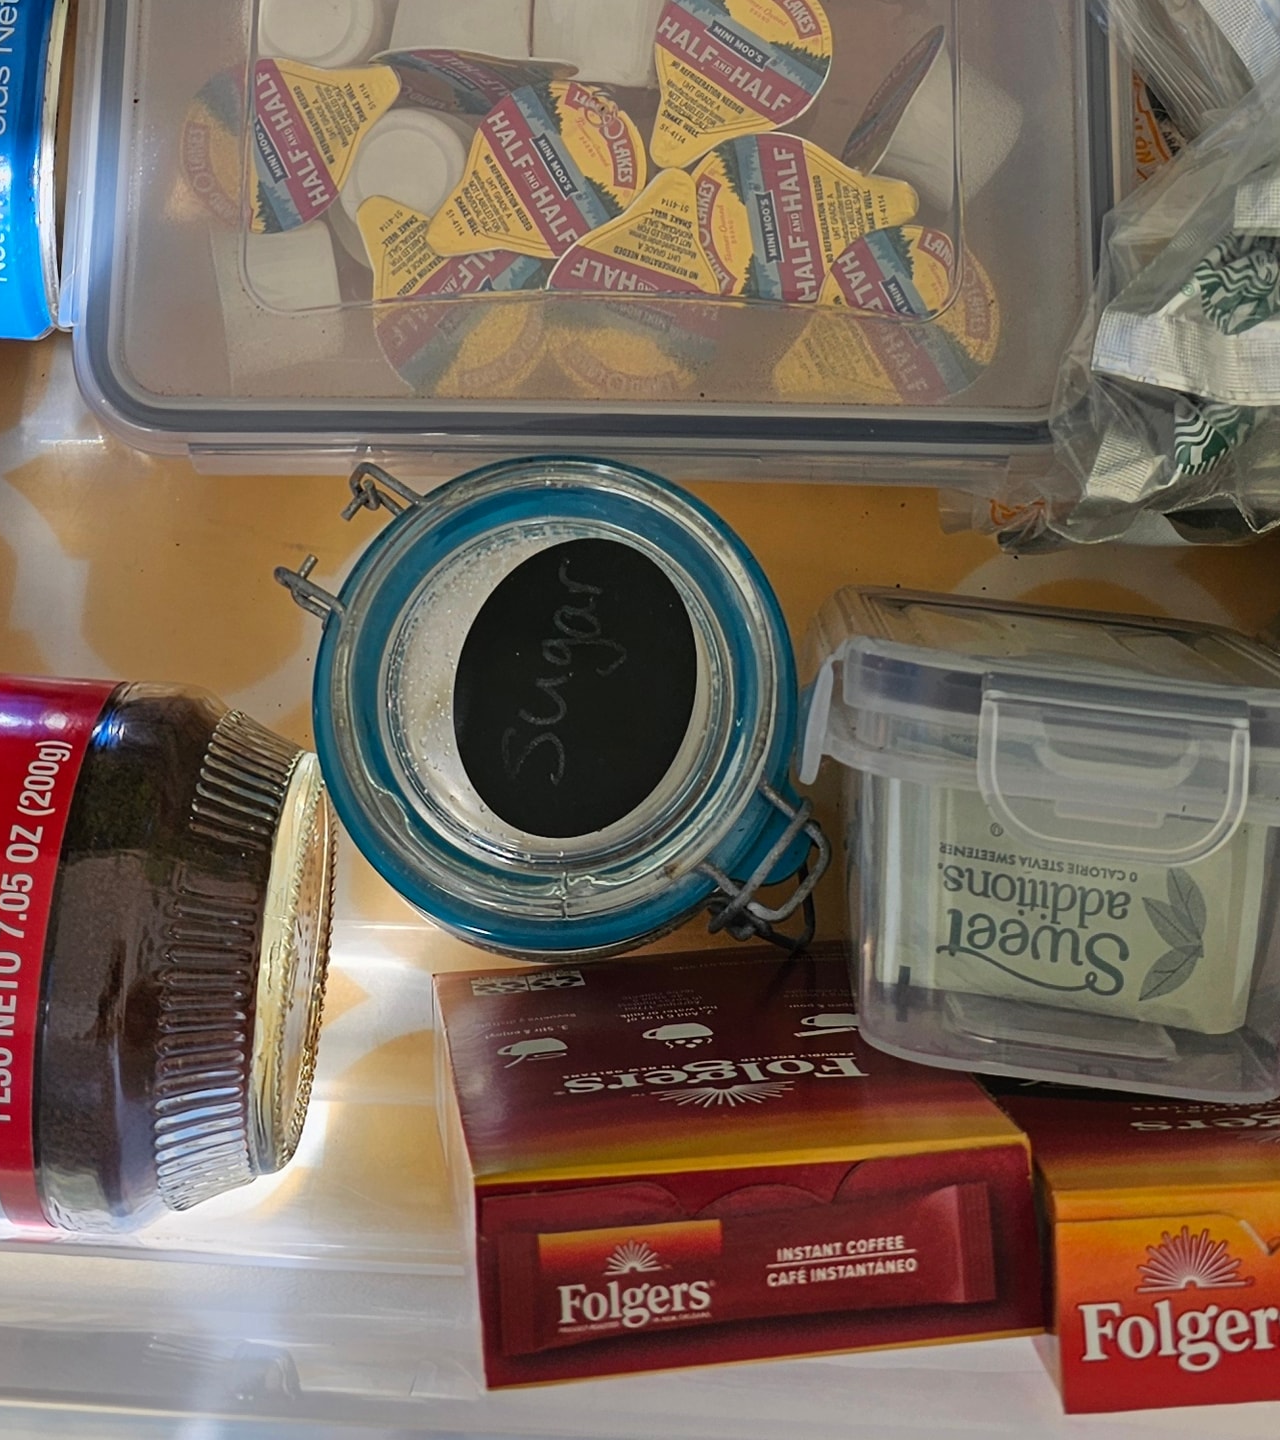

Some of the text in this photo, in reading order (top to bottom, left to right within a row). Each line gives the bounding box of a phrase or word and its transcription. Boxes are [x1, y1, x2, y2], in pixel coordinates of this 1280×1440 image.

[657, 15, 793, 113] HALF AND HALF
[712, 24, 764, 65] MINI MOO'S
[486, 110, 579, 245] HALF AND HALF
[612, 137, 634, 185] LAKES
[772, 146, 819, 303] HALF AND HALF
[15, 737, 75, 818] (200g)
[7, 822, 44, 867] OZ
[939, 841, 1139, 884] 0 CALORIE STEVIA SWEETENER
[943, 862, 1132, 922] additions
[936, 907, 1131, 997] Sweet
[561, 1055, 872, 1095] Folgers
[766, 1256, 919, 1288] CAFÉ INSTANTÁNEO
[776, 1234, 906, 1263] INSTANT COFFEE
[556, 1279, 712, 1328] Folgers
